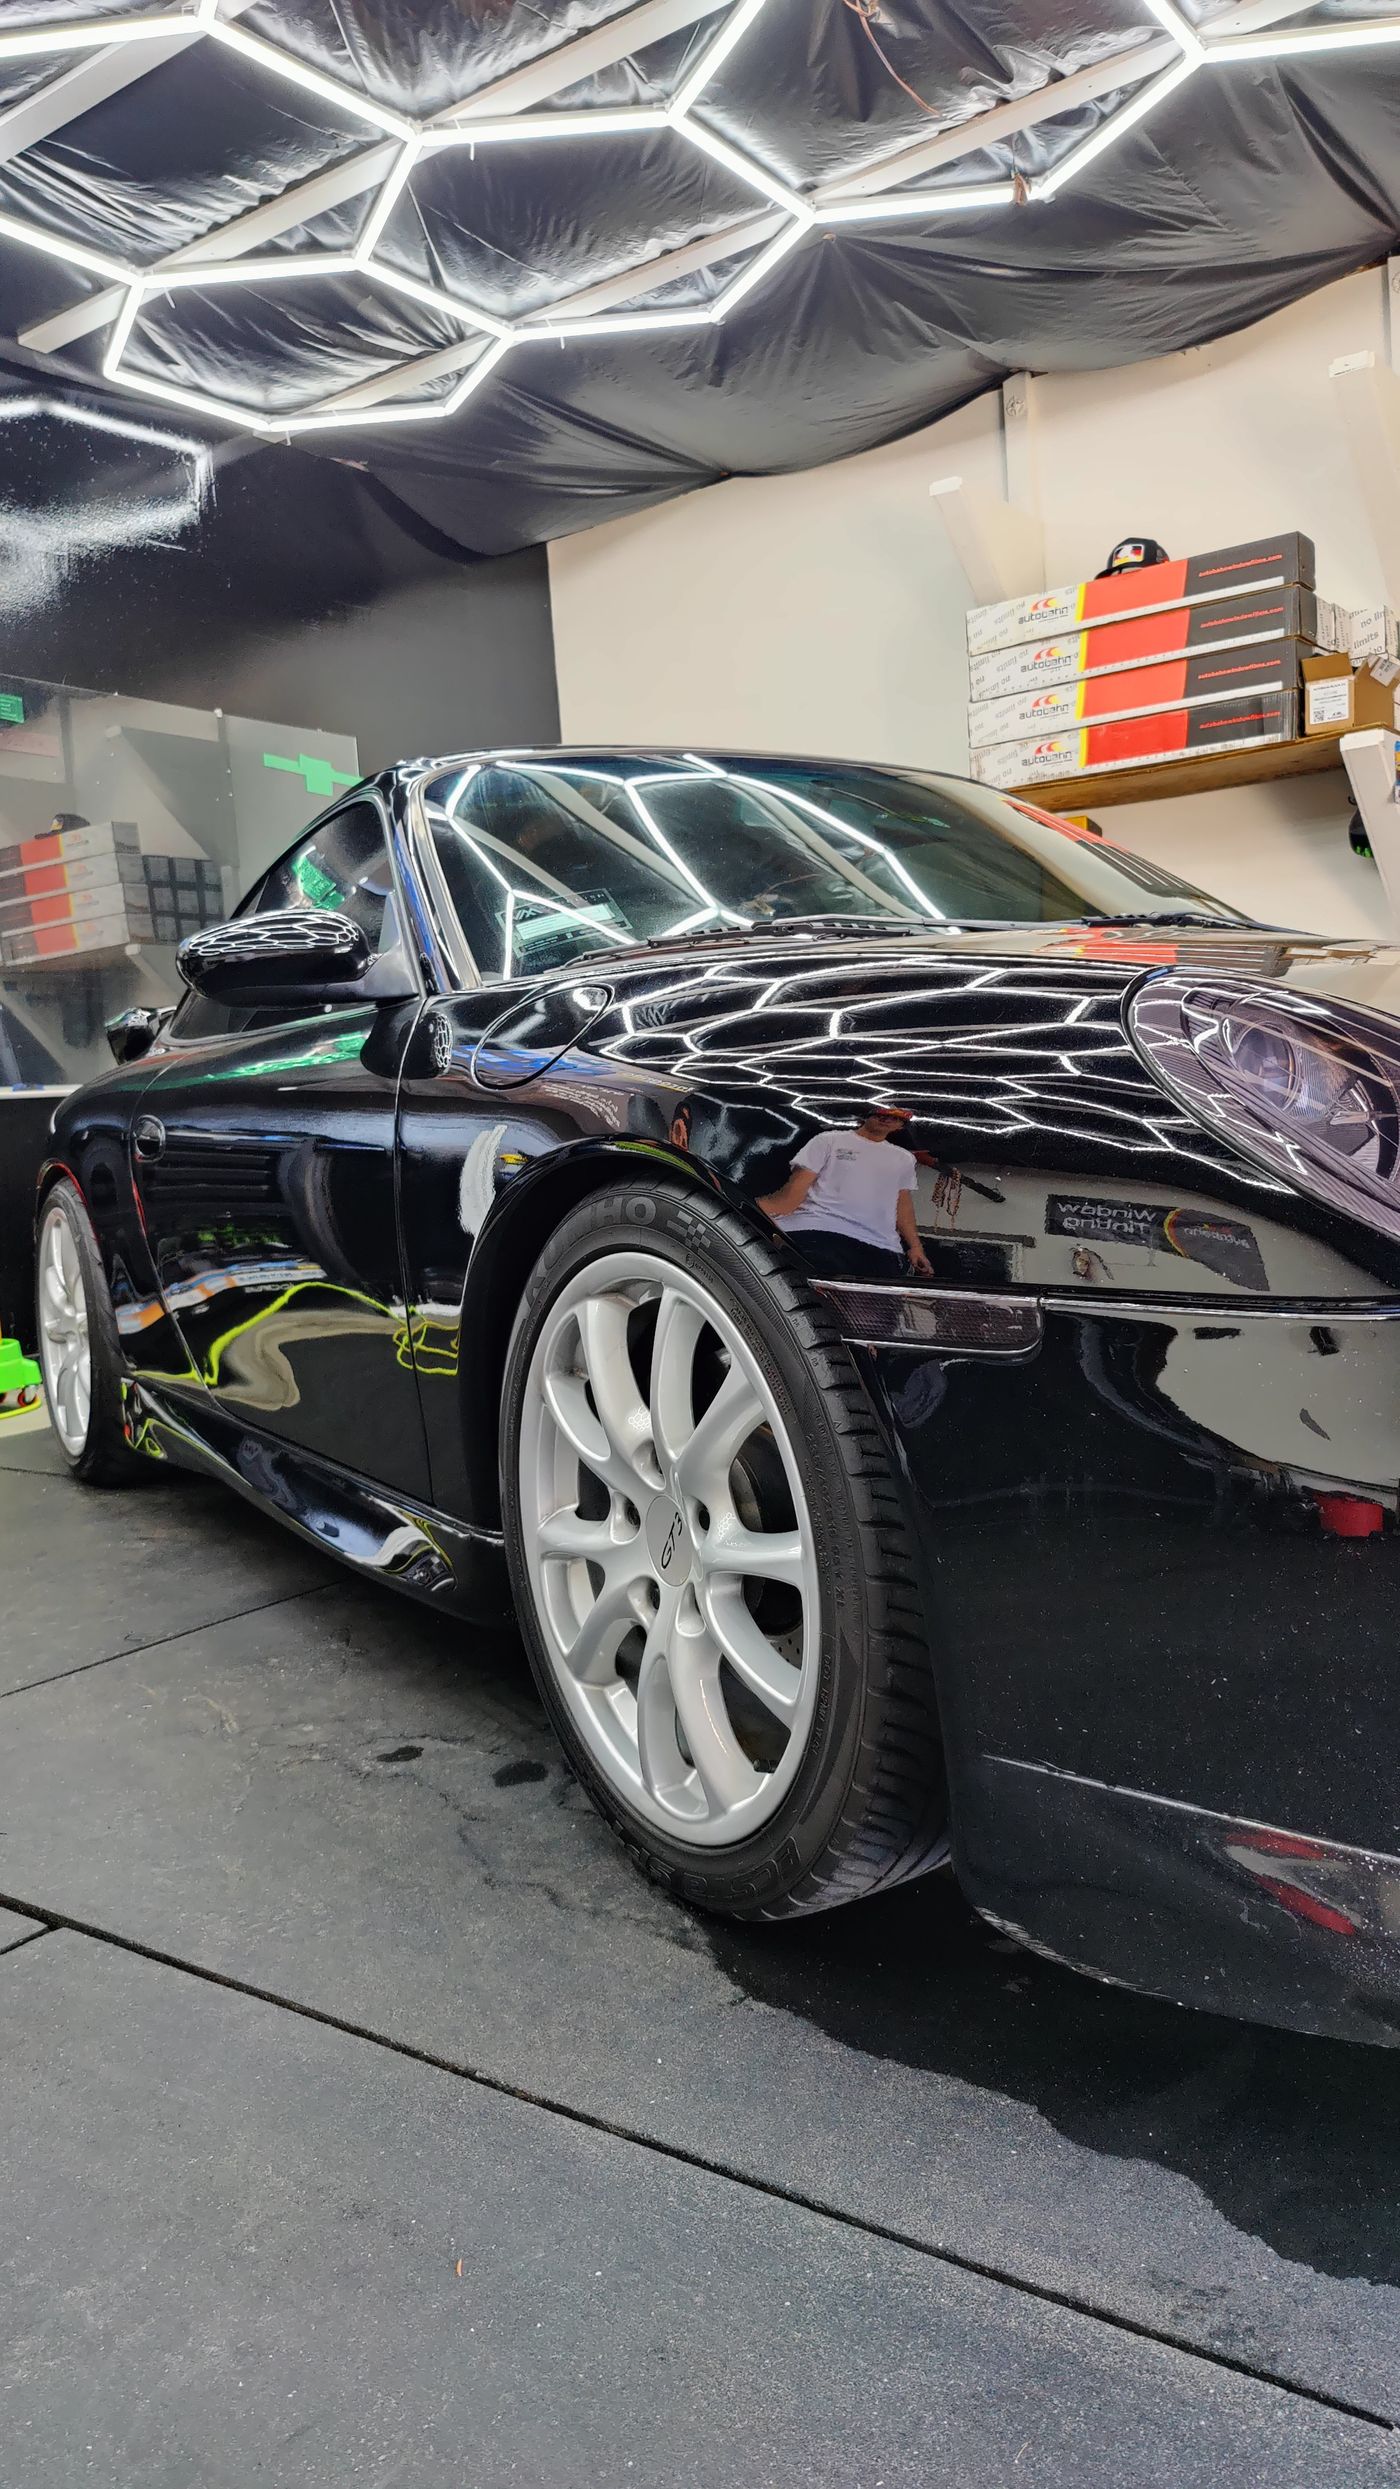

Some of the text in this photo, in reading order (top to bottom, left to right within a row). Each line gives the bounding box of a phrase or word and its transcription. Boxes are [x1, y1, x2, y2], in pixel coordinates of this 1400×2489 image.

[1361, 618, 1372, 628] no
[1353, 631, 1379, 649] limits
[1021, 655, 1071, 673] autobahn
[1019, 703, 1069, 720] autobahn
[1021, 751, 1073, 766] autobahn
[661, 1511, 683, 1570] GT3
